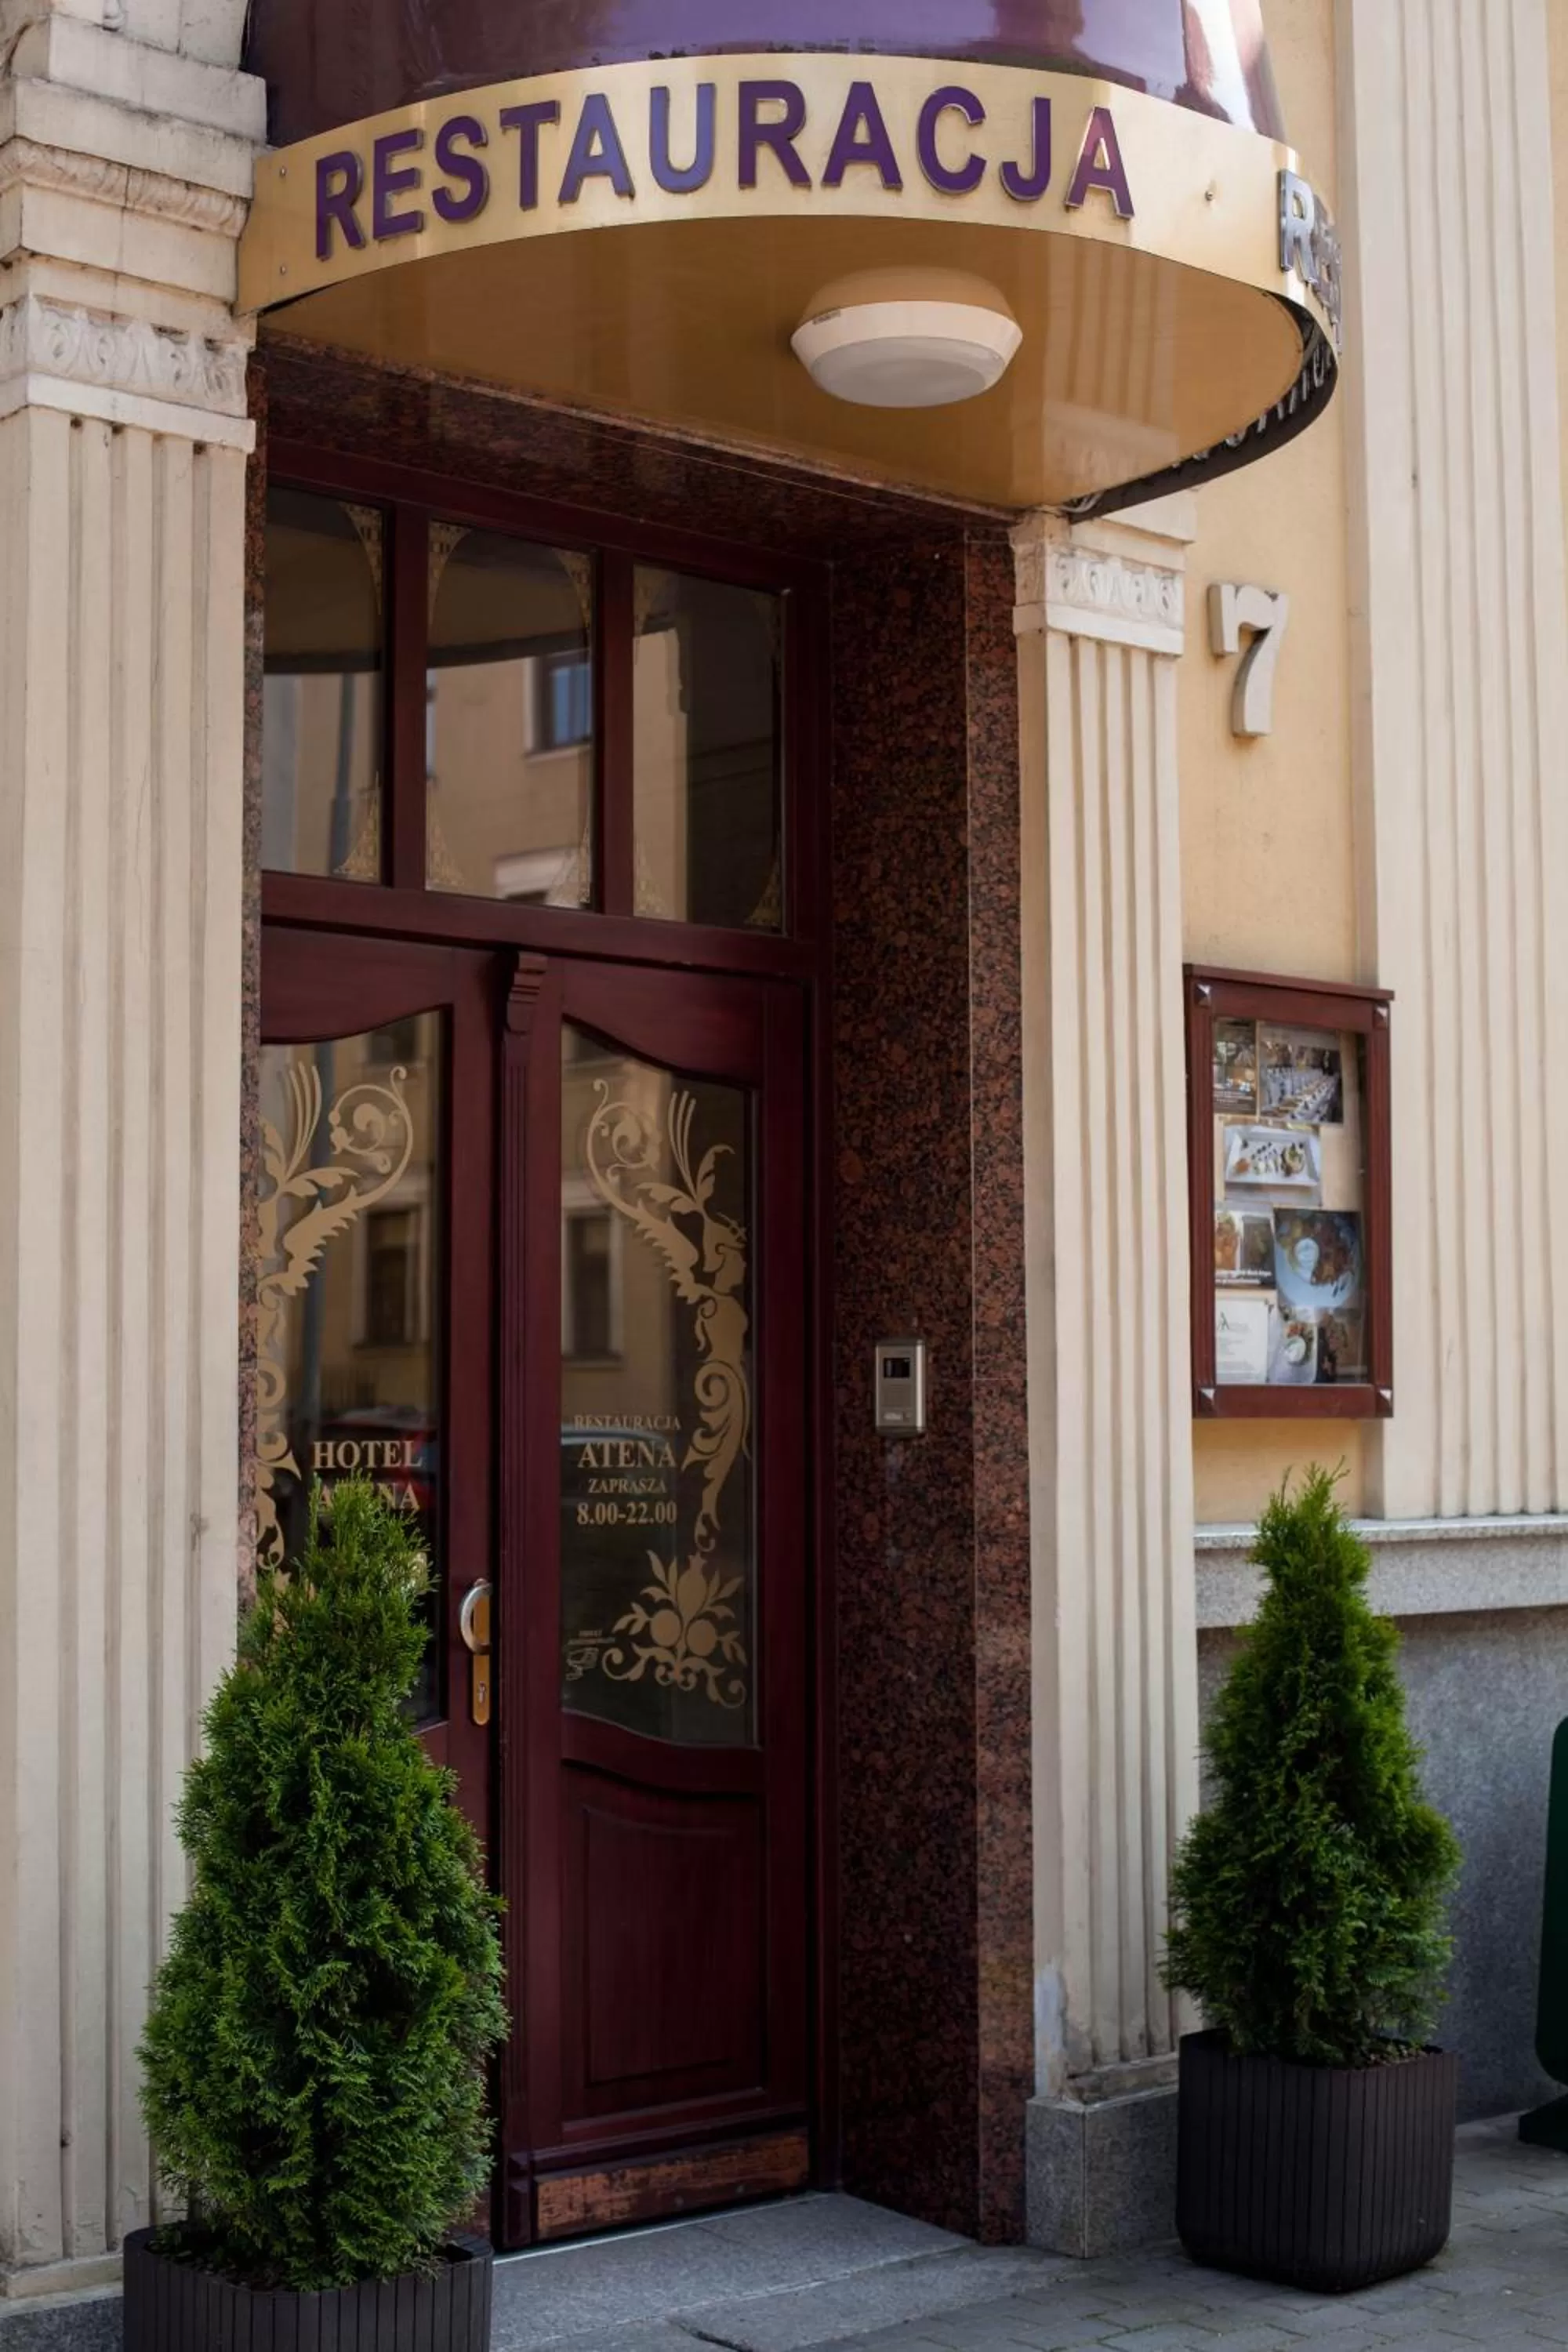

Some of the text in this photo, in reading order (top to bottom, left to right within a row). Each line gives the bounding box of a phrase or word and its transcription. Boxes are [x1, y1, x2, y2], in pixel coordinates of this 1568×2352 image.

[315, 79, 1134, 262] RESTAURACJA
[1207, 583, 1289, 737] 7
[573, 1414, 681, 1431] RESTAURACJA
[314, 1440, 423, 1468] HOTEL
[579, 1439, 677, 1468] ATENA
[316, 1481, 420, 1510] ANA
[588, 1478, 667, 1494] ZAPRASZA
[577, 1501, 677, 1524] 8.00-22.00
